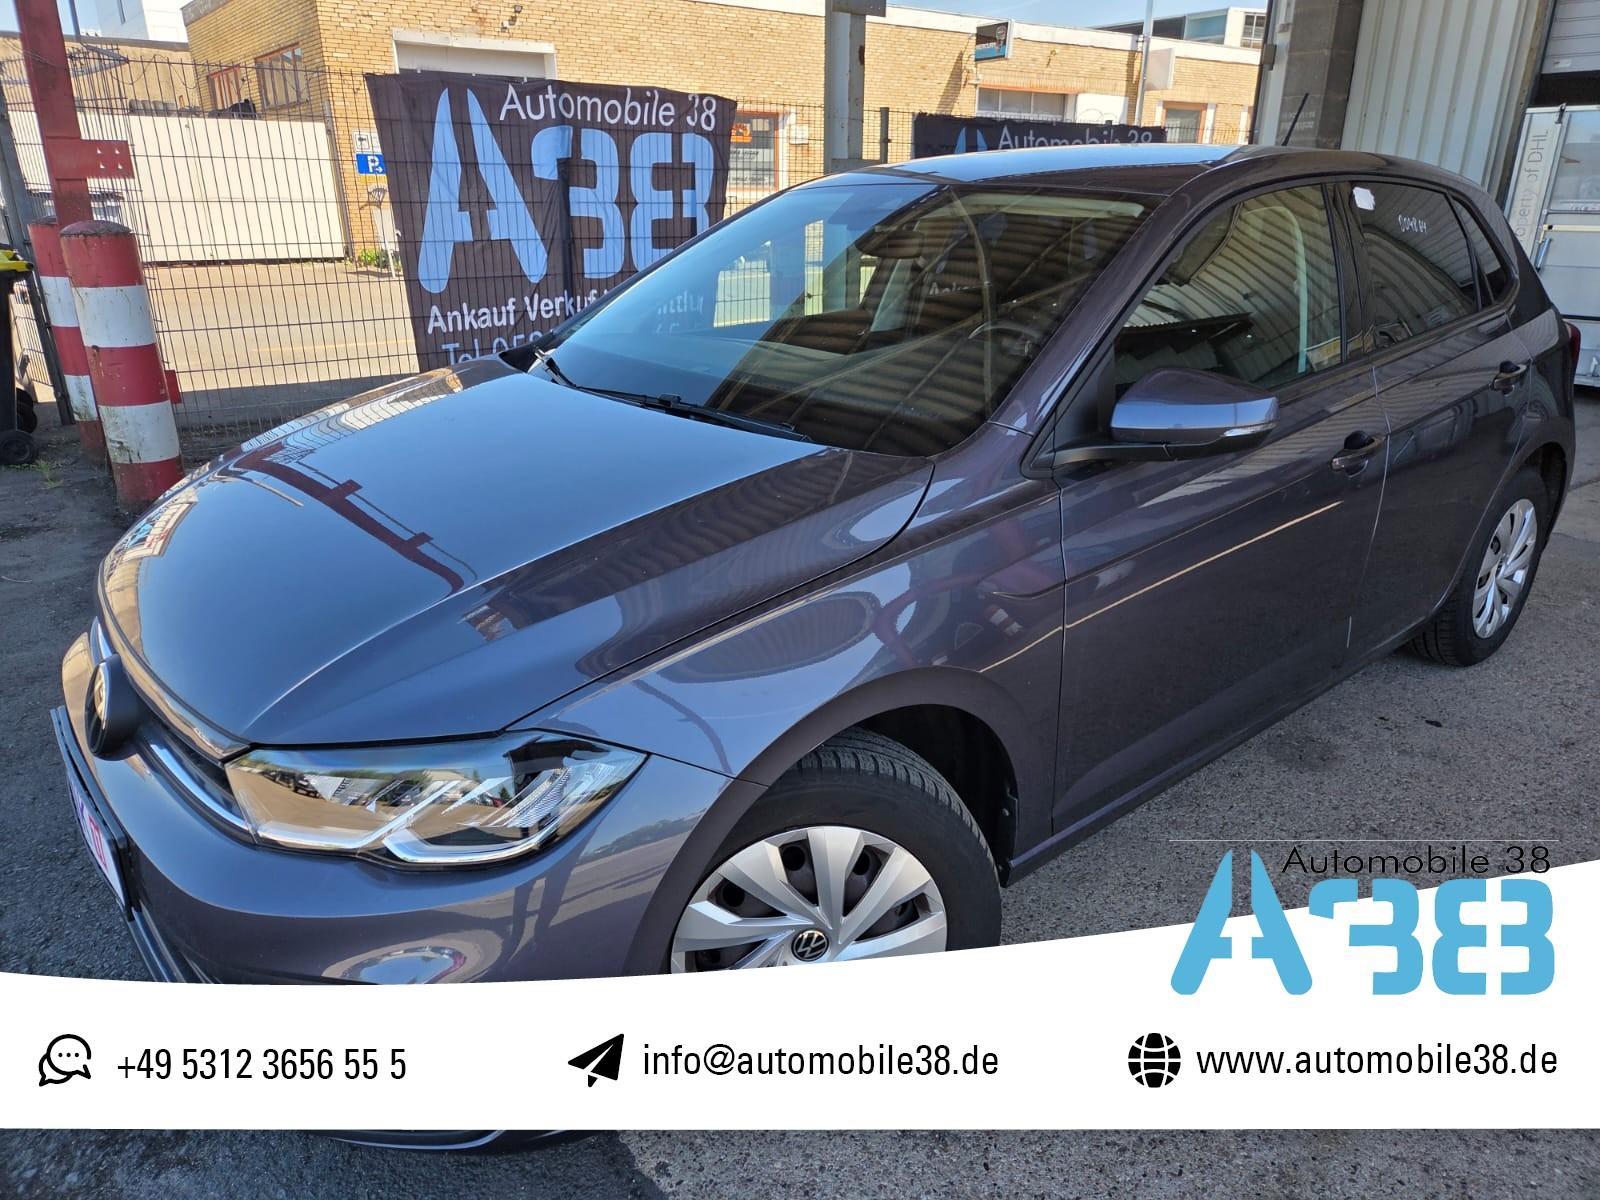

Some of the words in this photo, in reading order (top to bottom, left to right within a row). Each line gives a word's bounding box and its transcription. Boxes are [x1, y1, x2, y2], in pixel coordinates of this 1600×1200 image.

[500, 84, 675, 126] Automobile
[686, 93, 716, 132] 38
[367, 155, 380, 173] P
[1528, 130, 1549, 163] DHL
[428, 297, 516, 335] Ankauf
[524, 289, 598, 322] Verkuf
